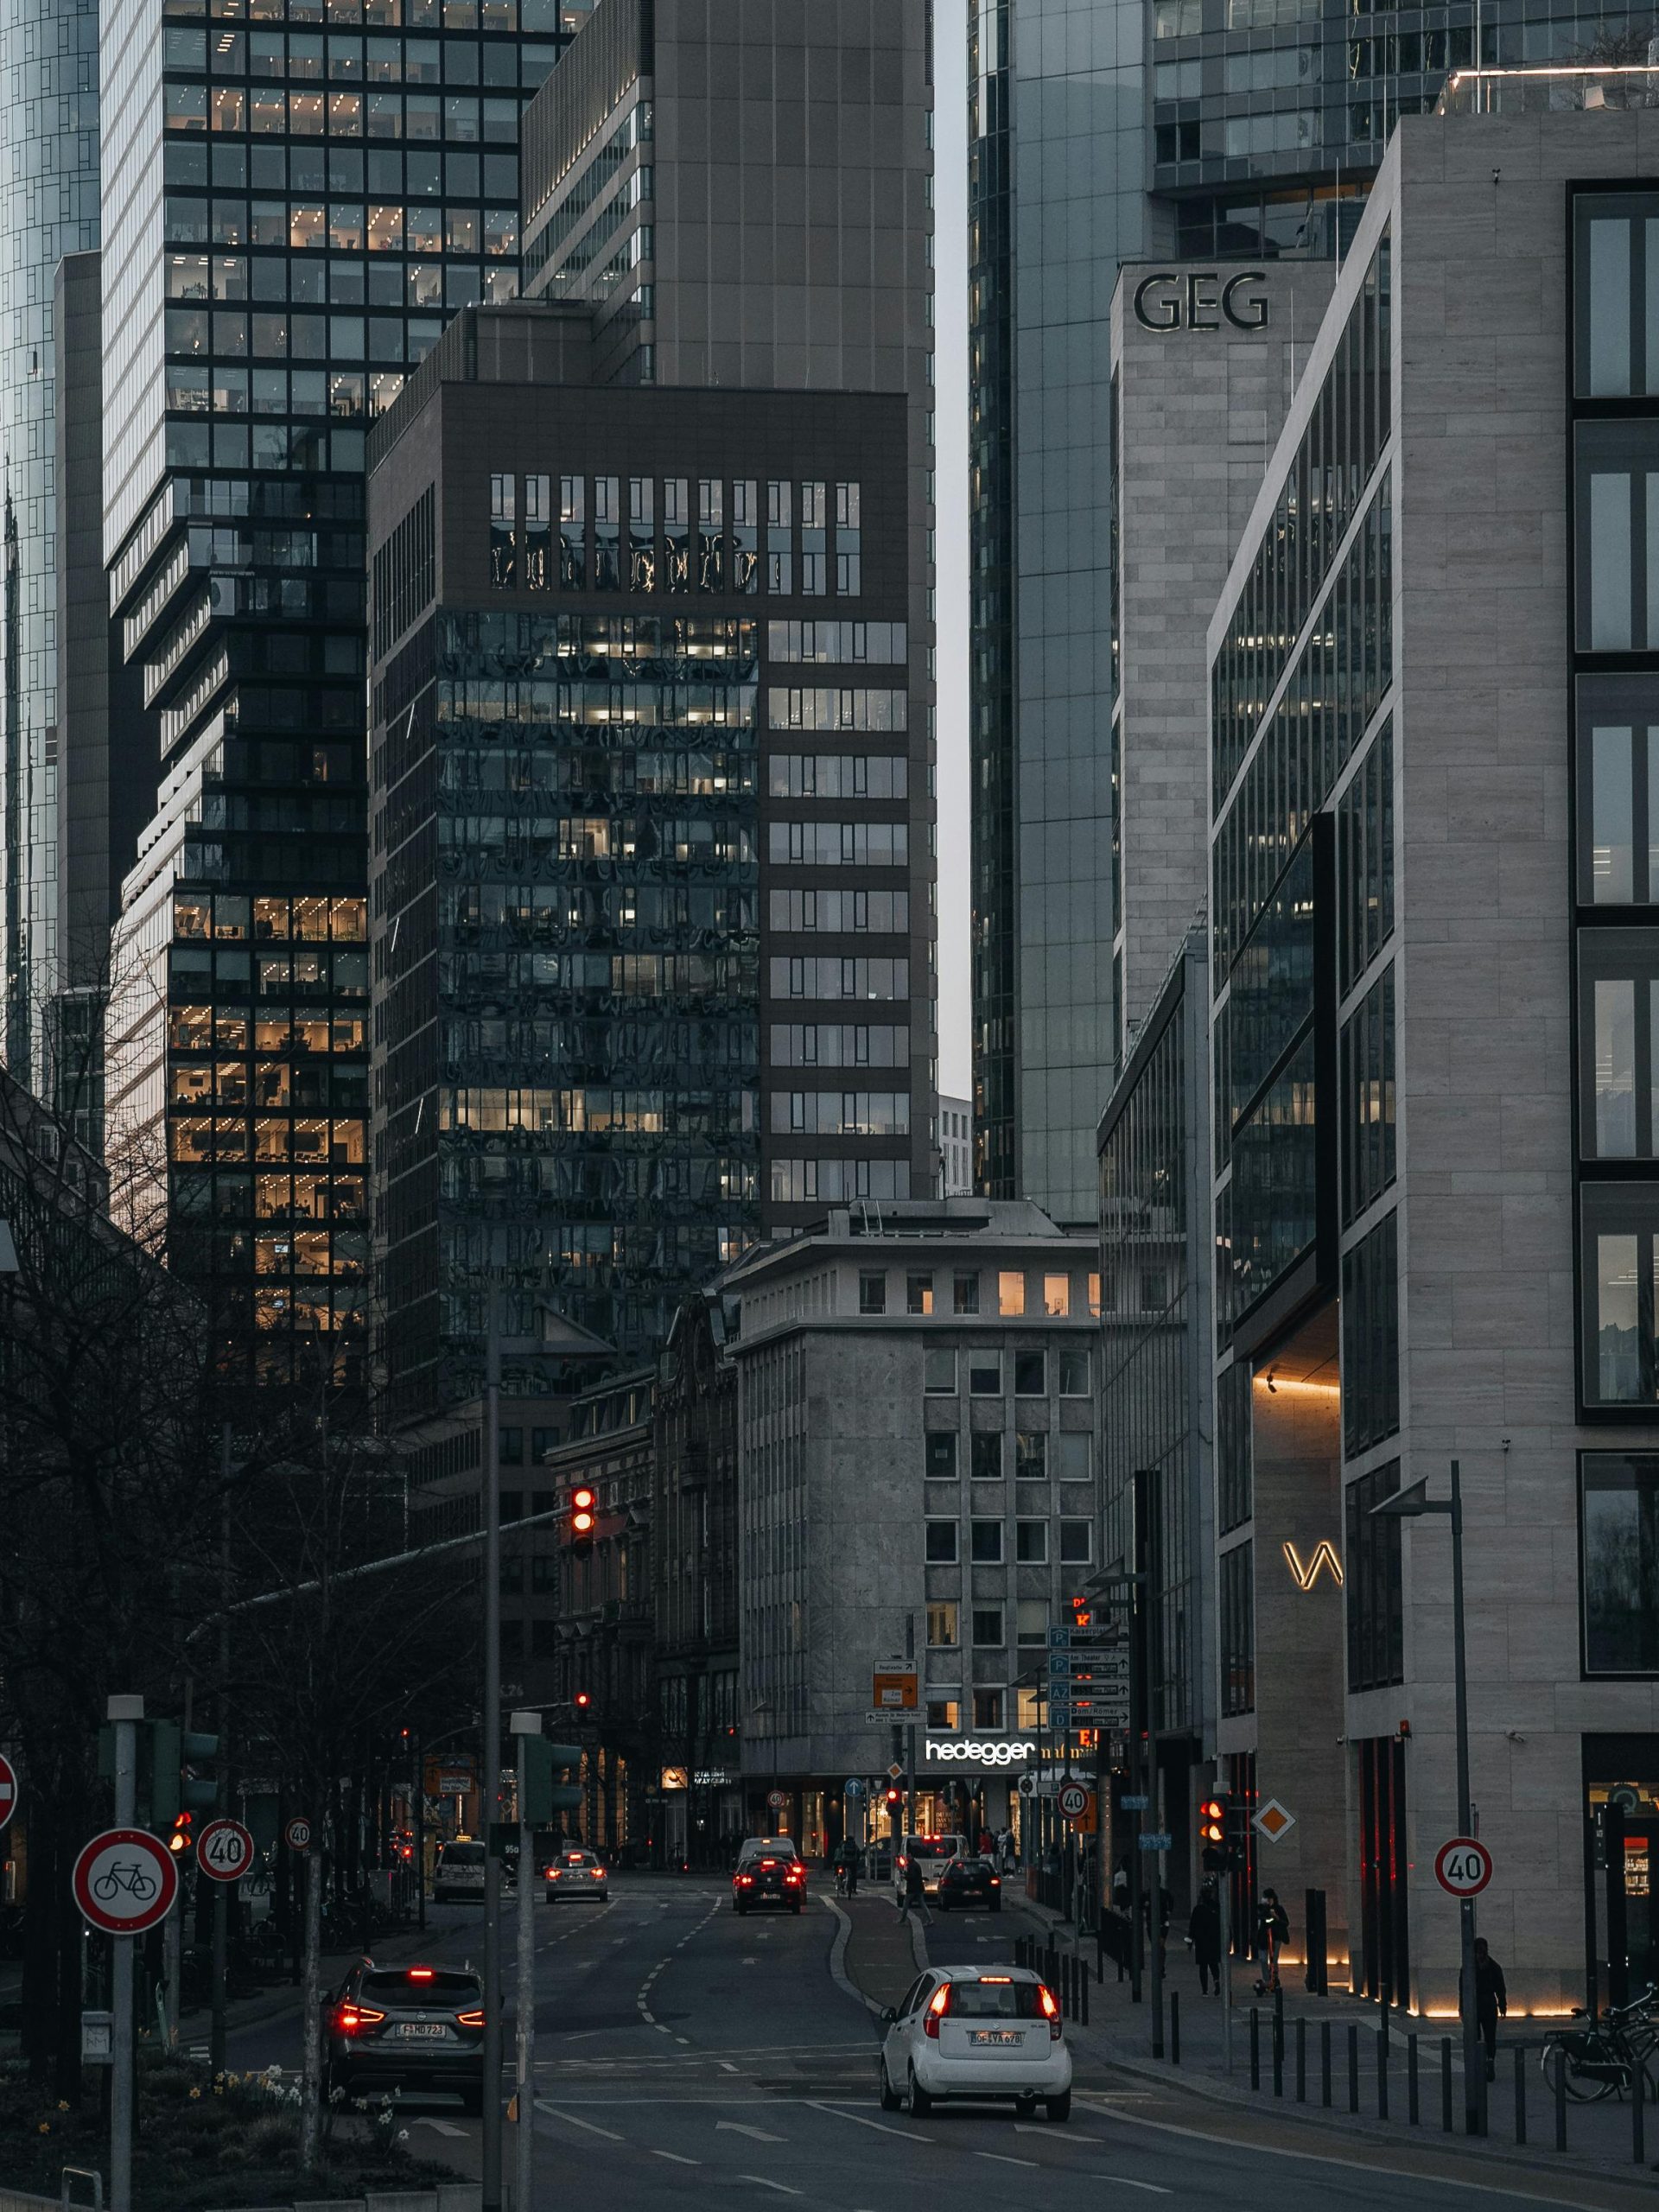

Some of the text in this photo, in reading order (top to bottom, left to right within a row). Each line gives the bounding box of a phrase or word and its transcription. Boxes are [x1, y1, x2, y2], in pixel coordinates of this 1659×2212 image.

[1134, 271, 1268, 332] GEG
[1052, 1688, 1068, 1699] AZ
[925, 1739, 1036, 1765] hedegger
[1065, 1793, 1083, 1808] 40
[292, 1827, 308, 1841] 40
[210, 1837, 241, 1863] 40
[505, 1845, 519, 1853] 95a
[1448, 1854, 1481, 1880] 40
